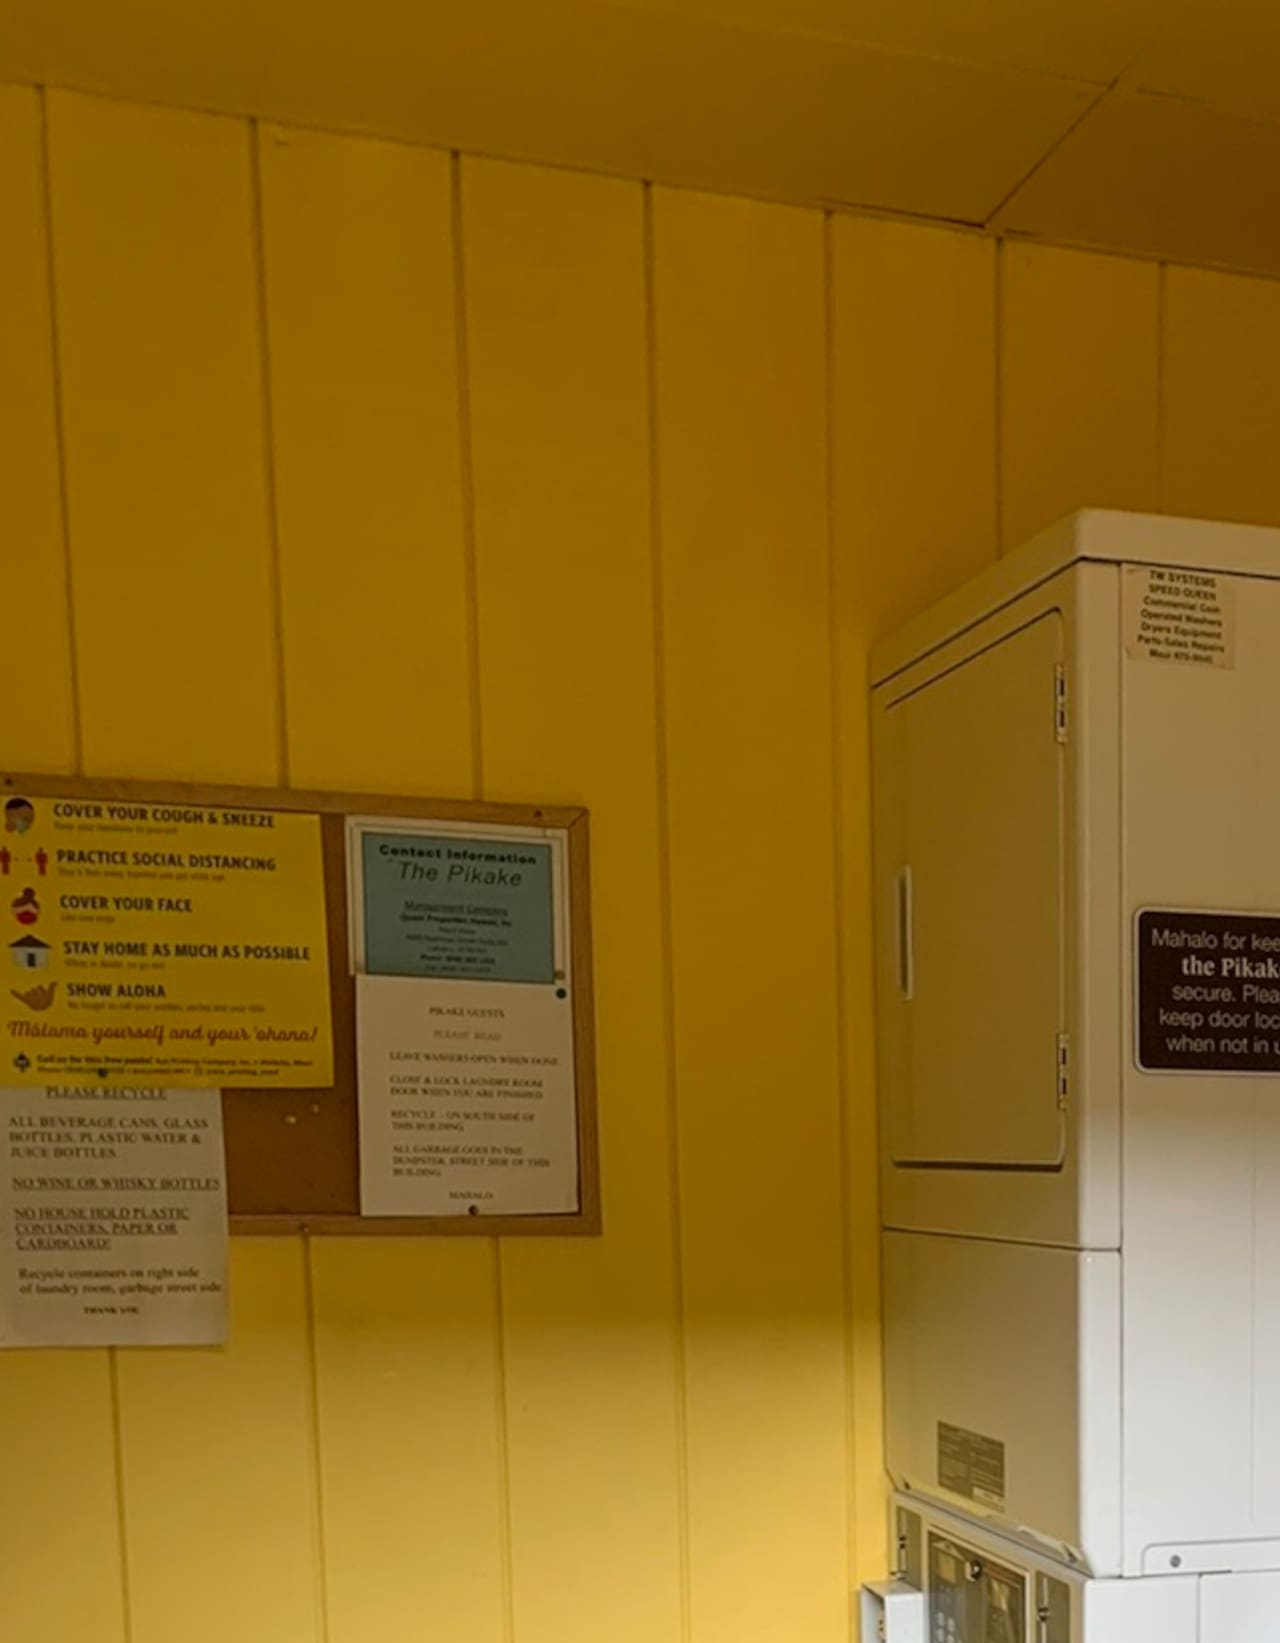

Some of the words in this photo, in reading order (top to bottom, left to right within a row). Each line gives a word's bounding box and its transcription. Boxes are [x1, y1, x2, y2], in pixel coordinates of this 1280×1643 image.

[1168, 572, 1217, 588] SYSTEMS
[1148, 583, 1180, 597] SPEED
[1184, 588, 1217, 601] QUEEN
[1143, 595, 1197, 610] Commercial
[1140, 608, 1183, 622] Operated
[1174, 625, 1222, 639] Equipment
[53, 803, 102, 819] COVER
[107, 806, 148, 821] YOUR
[152, 808, 203, 825] COUGH
[208, 811, 217, 825] &
[222, 813, 275, 829] SNEEZE
[57, 849, 128, 866] PRACTICE
[132, 852, 184, 868] SOCIAL
[189, 855, 276, 871] DISTANCING
[379, 844, 441, 859] Contact
[447, 848, 537, 864] Information
[399, 861, 438, 881] The
[448, 864, 523, 888] Pikake
[60, 895, 108, 911] COVER
[113, 897, 153, 911] YOUR
[158, 898, 192, 912] FACE
[1151, 928, 1218, 950] Mahalo
[1222, 931, 1247, 951] for
[63, 941, 99, 956] STAY
[104, 943, 146, 957] HOME
[152, 944, 171, 957] AS
[174, 944, 218, 959] MUCH
[222, 945, 240, 959] AS
[244, 946, 310, 961] POSSIBLE
[1181, 954, 1216, 977] the
[66, 983, 111, 998] SHOW
[117, 984, 166, 999] ALOHA
[1171, 985, 1237, 1003] secure.
[1159, 1007, 1204, 1030] keep
[1208, 1010, 1250, 1029] door
[92, 1023, 164, 1046] yourself
[169, 1026, 202, 1041] and
[206, 1028, 248, 1047] your
[1166, 1034, 1216, 1053] when
[1219, 1037, 1249, 1054] not
[1252, 1036, 1270, 1054] in
[471, 1053, 496, 1063] OPEN
[499, 1055, 528, 1064] WHEN
[46, 1086, 98, 1101] PLEASE
[101, 1087, 167, 1101] RECYCLE
[8, 1116, 37, 1128] ALL
[40, 1116, 114, 1128] BEVERAGE
[164, 1118, 208, 1129] GLASS
[80, 1132, 136, 1143] PLASTIC
[141, 1132, 187, 1144] WATER
[191, 1133, 201, 1144] &
[10, 1147, 48, 1159] JUICE
[12, 1177, 34, 1190] NO
[37, 1177, 72, 1190] WINE
[78, 1177, 97, 1190] OR
[103, 1177, 156, 1190] WHISKY
[161, 1177, 219, 1190] BOTTLES
[14, 1207, 36, 1220] NO
[39, 1207, 87, 1220] HOUSE
[90, 1207, 130, 1220] HOLD
[133, 1208, 190, 1220] PLASTIC
[112, 1222, 154, 1236] PAPER
[158, 1222, 178, 1235] OR
[19, 1268, 65, 1281] Recycle
[68, 1268, 127, 1279] containers
[130, 1270, 144, 1279] on
[148, 1267, 173, 1281] right
[177, 1266, 199, 1279] side
[19, 1283, 33, 1294] of
[35, 1283, 78, 1297] laundry
[119, 1283, 163, 1296] garbage
[167, 1282, 197, 1293] street
